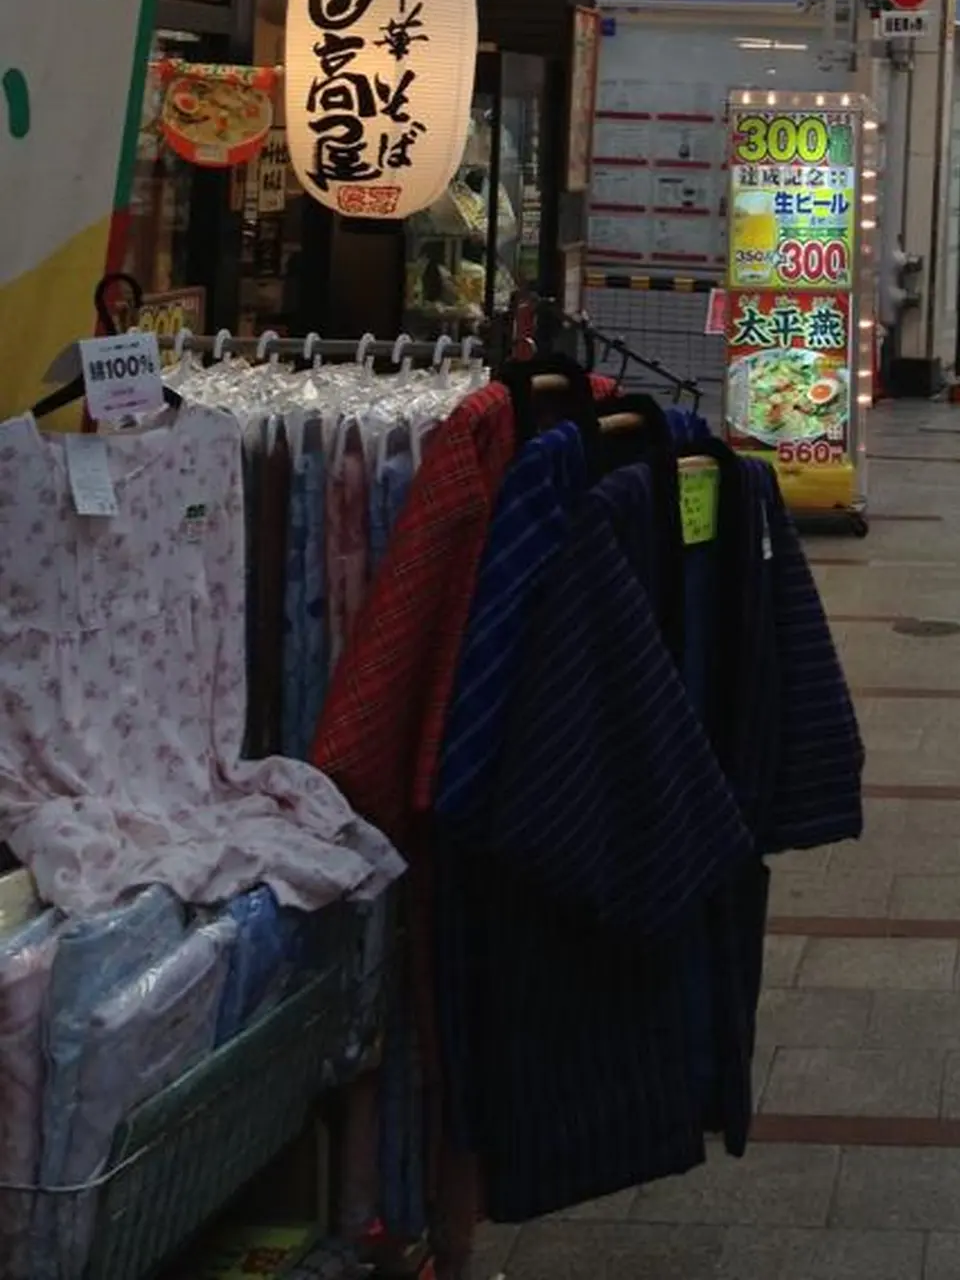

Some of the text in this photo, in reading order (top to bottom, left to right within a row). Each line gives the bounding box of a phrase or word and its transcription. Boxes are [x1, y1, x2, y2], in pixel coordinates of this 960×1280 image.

[736, 117, 829, 163] 300
[775, 191, 850, 215] 生ビール
[733, 306, 846, 347] 太平燕
